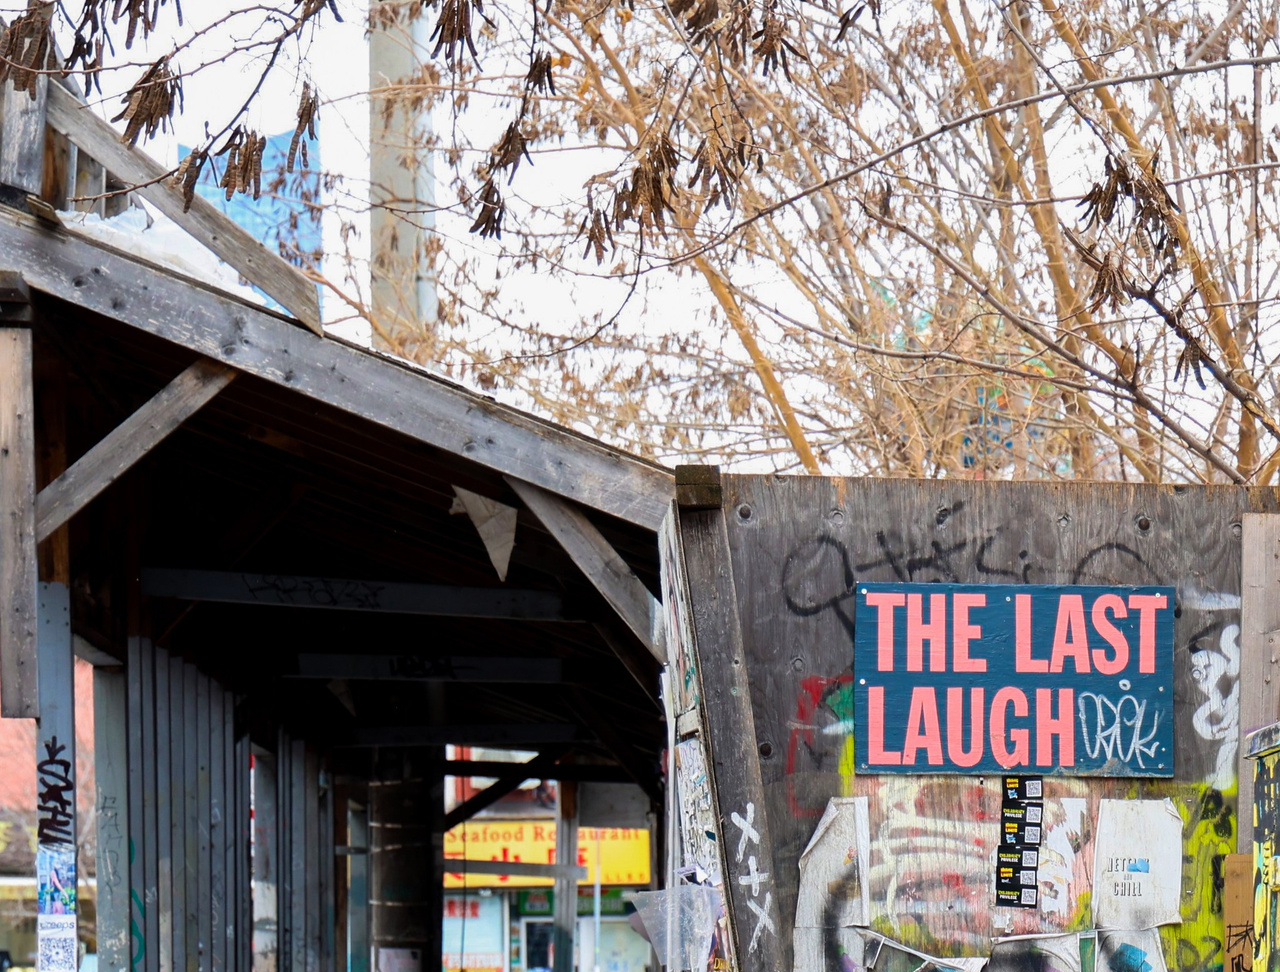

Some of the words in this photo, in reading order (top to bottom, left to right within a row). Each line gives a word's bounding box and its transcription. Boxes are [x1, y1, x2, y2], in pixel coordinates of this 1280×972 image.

[865, 592, 988, 673] THE
[1014, 593, 1168, 676] LAST
[867, 685, 1075, 768] LAUGH
[446, 825, 525, 843] Seafood
[533, 827, 641, 843] Reaurant
[1113, 881, 1142, 897] CHILL
